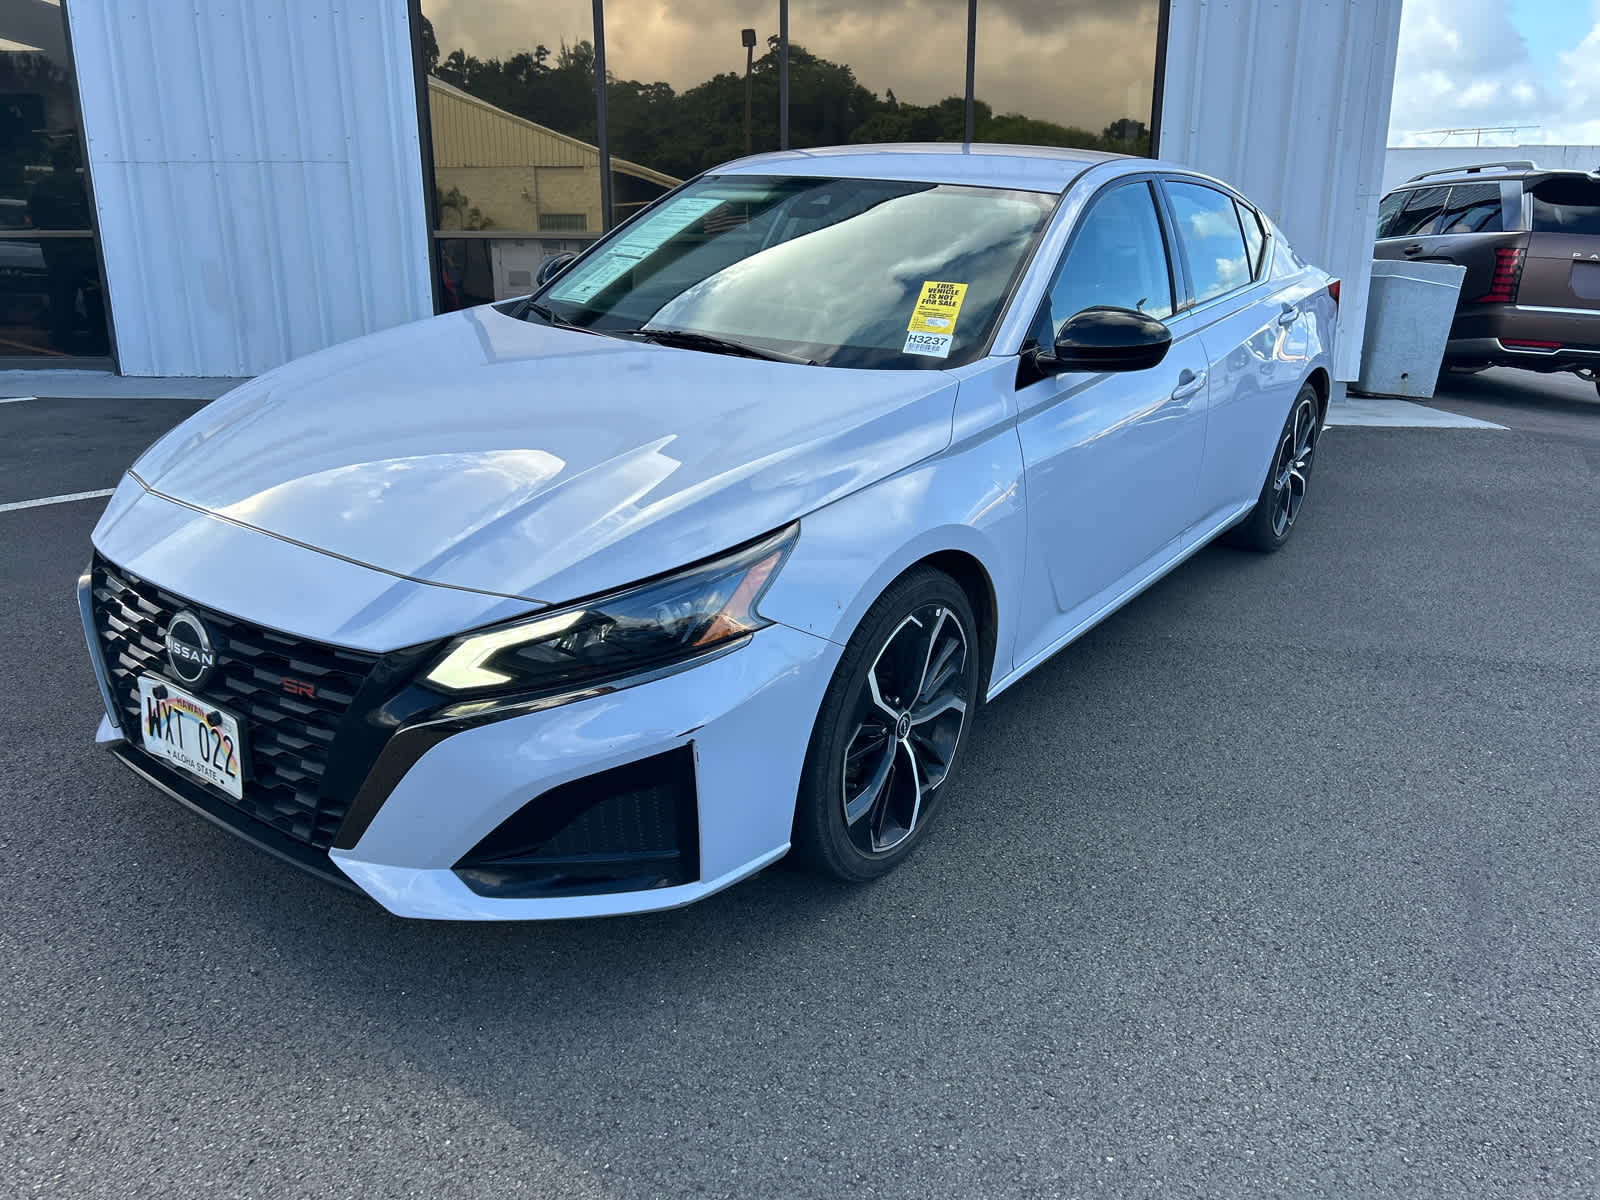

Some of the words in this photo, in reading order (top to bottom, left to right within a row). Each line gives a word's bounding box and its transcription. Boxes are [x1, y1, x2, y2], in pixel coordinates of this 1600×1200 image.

[928, 287, 960, 295] VEHICLE
[938, 299, 957, 307] SALE
[908, 334, 949, 346] H3237
[164, 633, 213, 665] NISSAN
[282, 678, 314, 697] SR
[147, 696, 184, 750] WXT
[198, 721, 236, 778] 022
[172, 751, 195, 768] ALOHA
[196, 763, 218, 781] STATE
